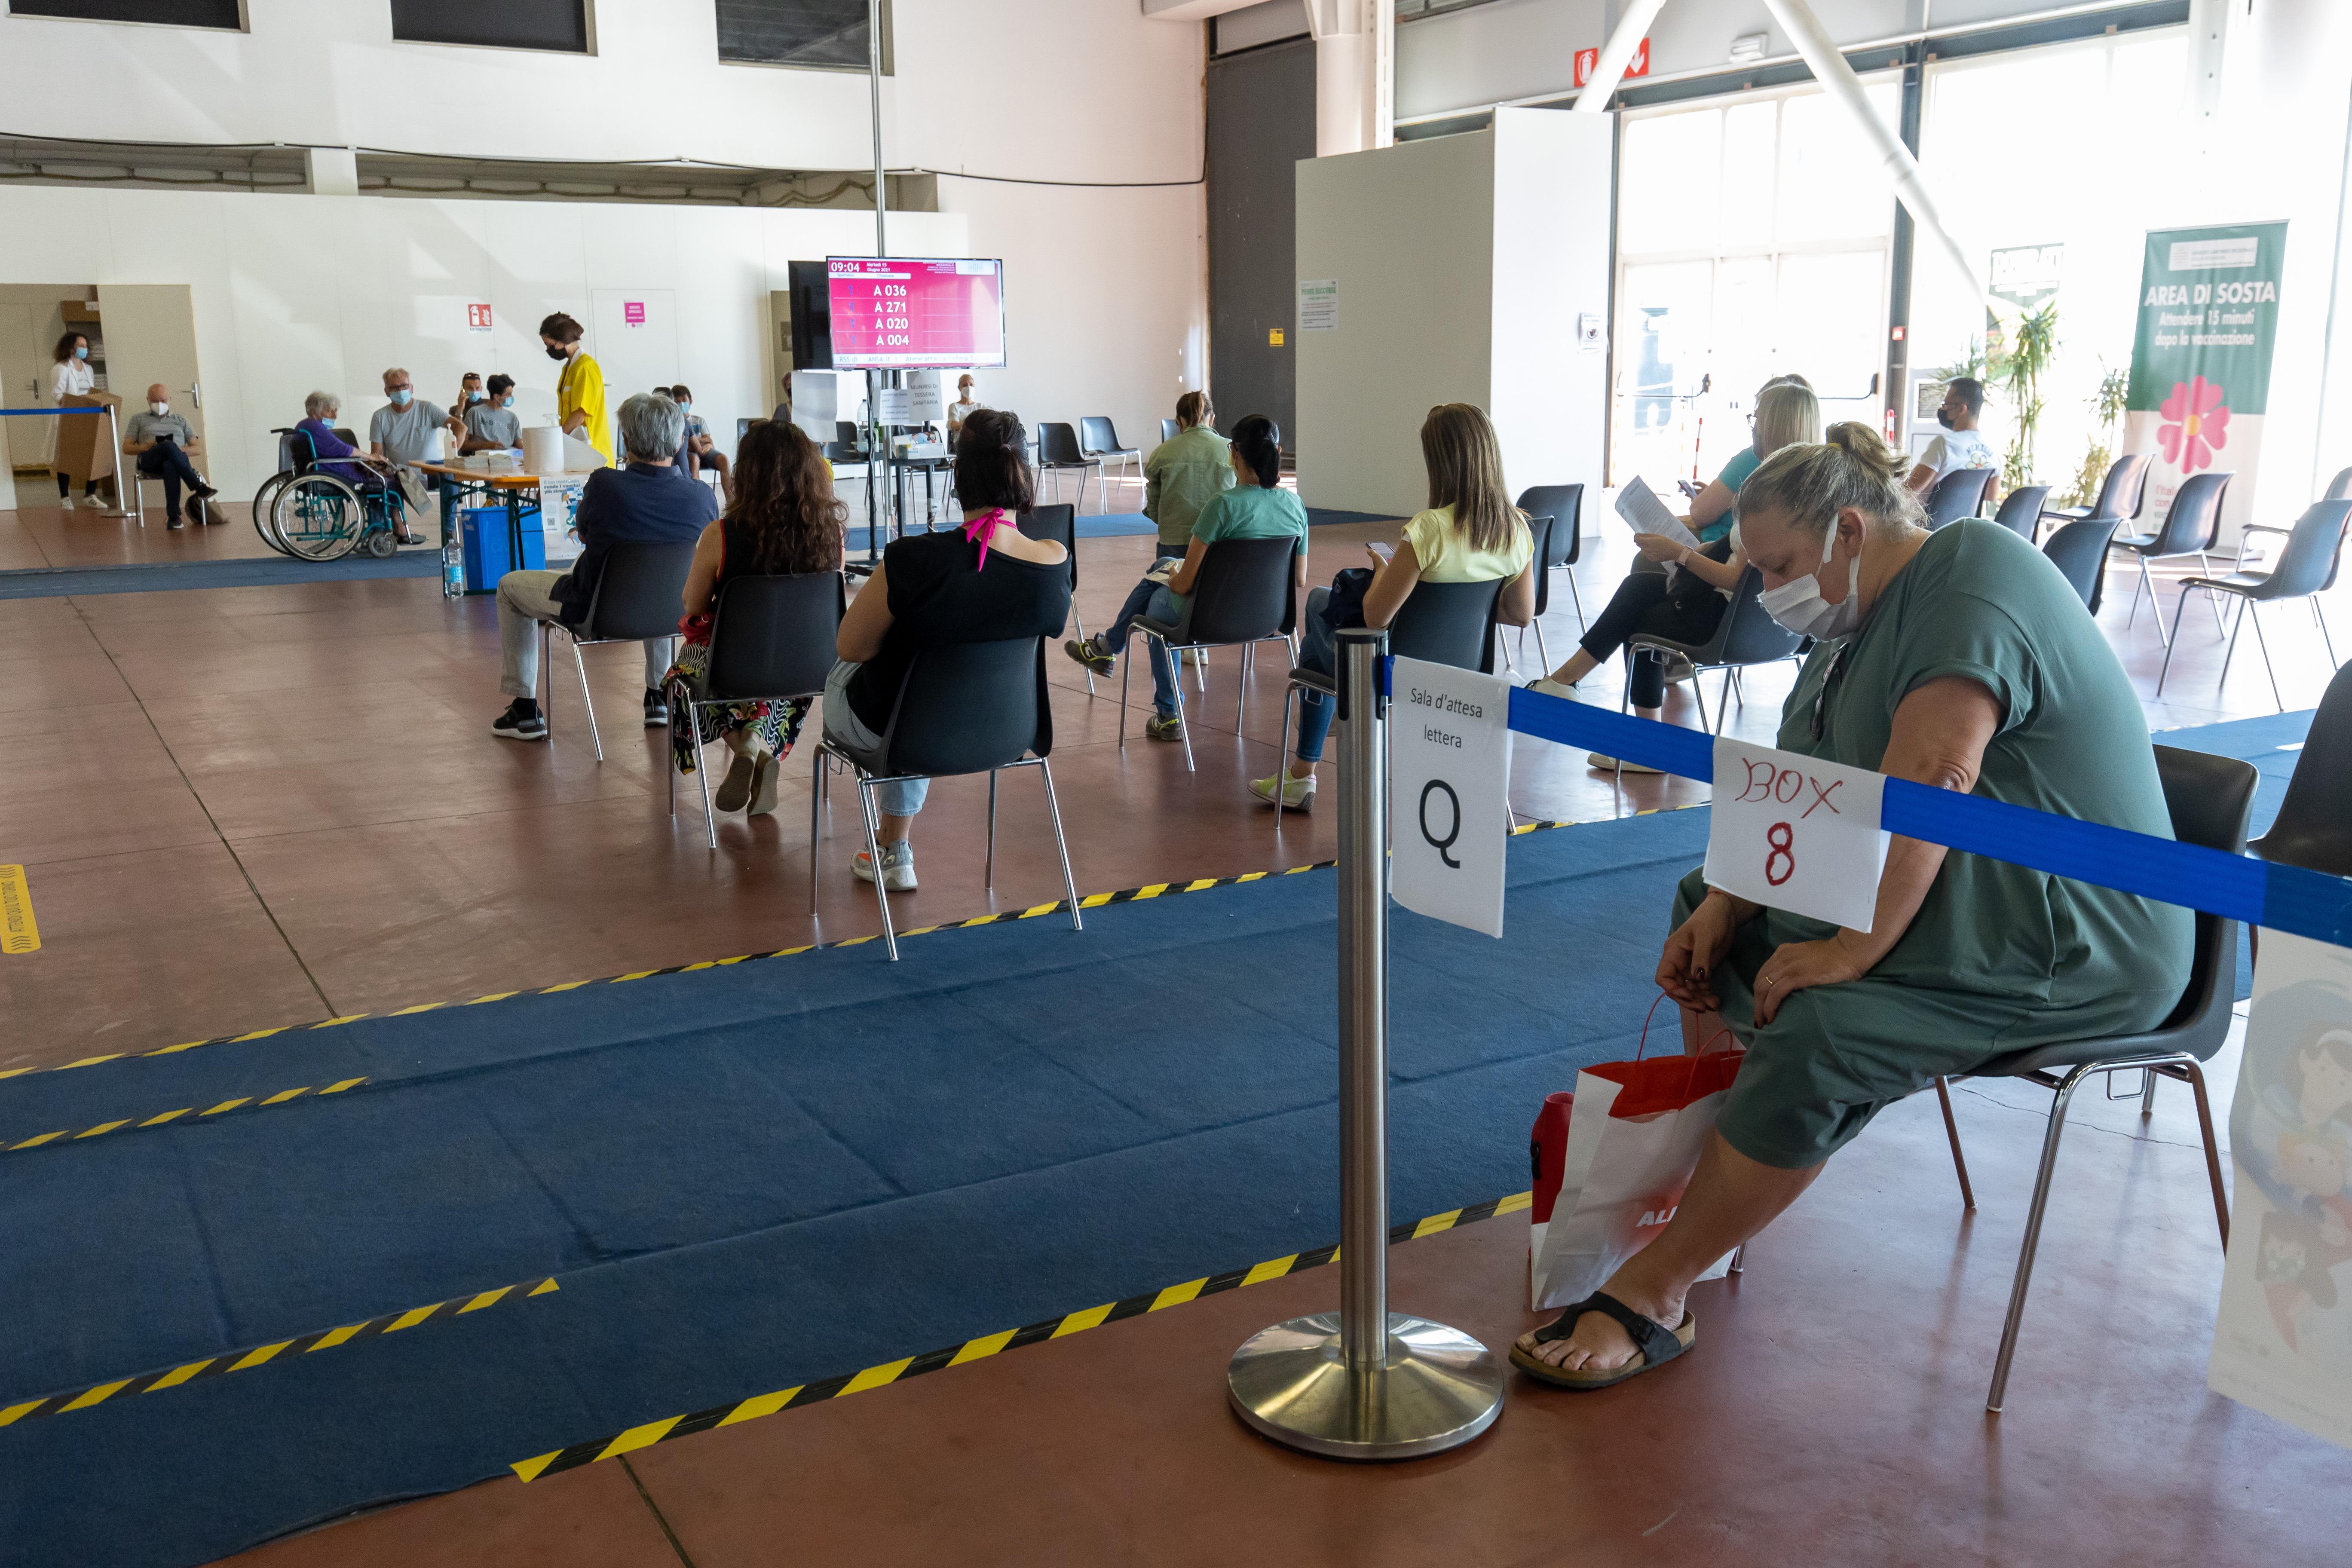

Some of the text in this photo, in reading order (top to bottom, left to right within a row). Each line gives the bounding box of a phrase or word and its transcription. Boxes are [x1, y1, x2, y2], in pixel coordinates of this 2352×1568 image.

[831, 262, 860, 272] 09:04
[848, 285, 907, 296] 1 A 036
[2144, 281, 2277, 306] AREA DI SOSTA
[849, 301, 906, 312] 1 A 271
[2159, 308, 2255, 326] Attendere 15 minuti
[850, 318, 908, 329] 1 A 020
[851, 334, 909, 346] 1 A 004
[2155, 328, 2255, 350] dopo la vaccinazione
[1411, 688, 1482, 718] Sala d'attesa
[1424, 723, 1462, 748] lettera
[1735, 757, 1843, 818] BOX
[1419, 778, 1461, 869] Q
[1765, 821, 1795, 886] 8
